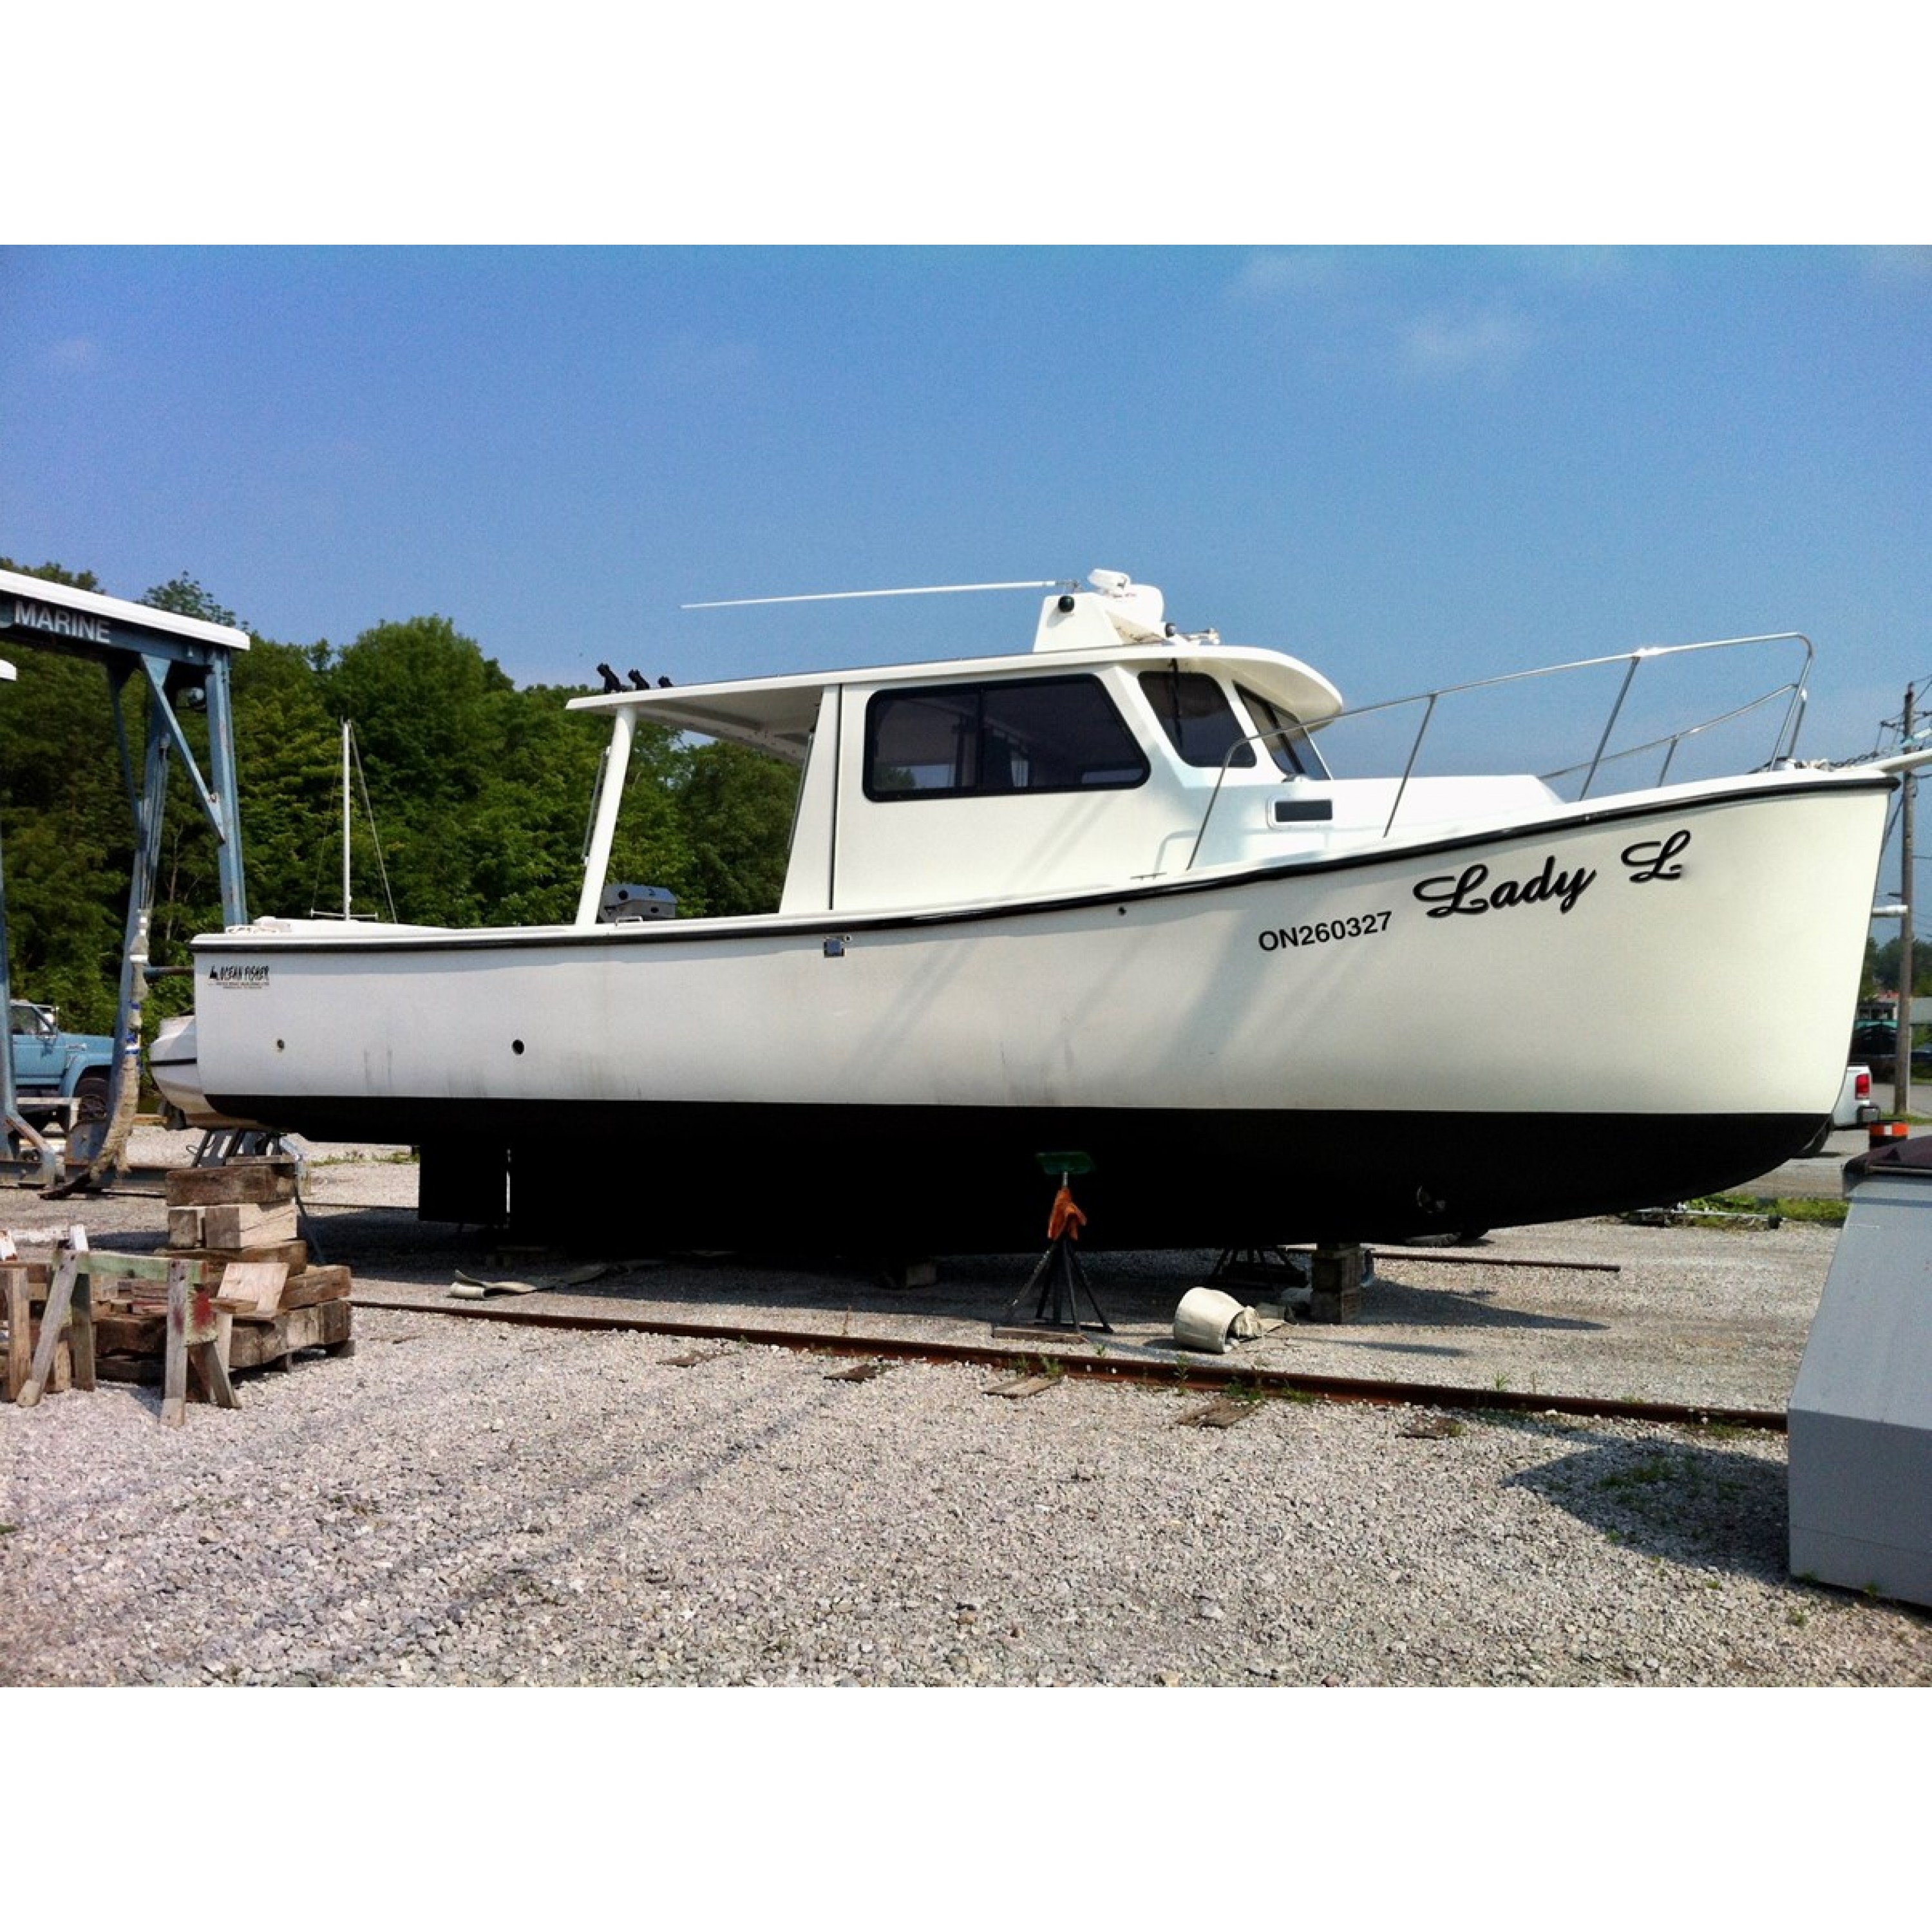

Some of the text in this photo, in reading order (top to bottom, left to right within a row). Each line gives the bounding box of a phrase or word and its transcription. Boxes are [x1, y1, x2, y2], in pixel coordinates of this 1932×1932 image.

[15, 600, 111, 643] MARINE
[1414, 829, 1691, 917] Lady L
[1258, 911, 1392, 952] ON260327
